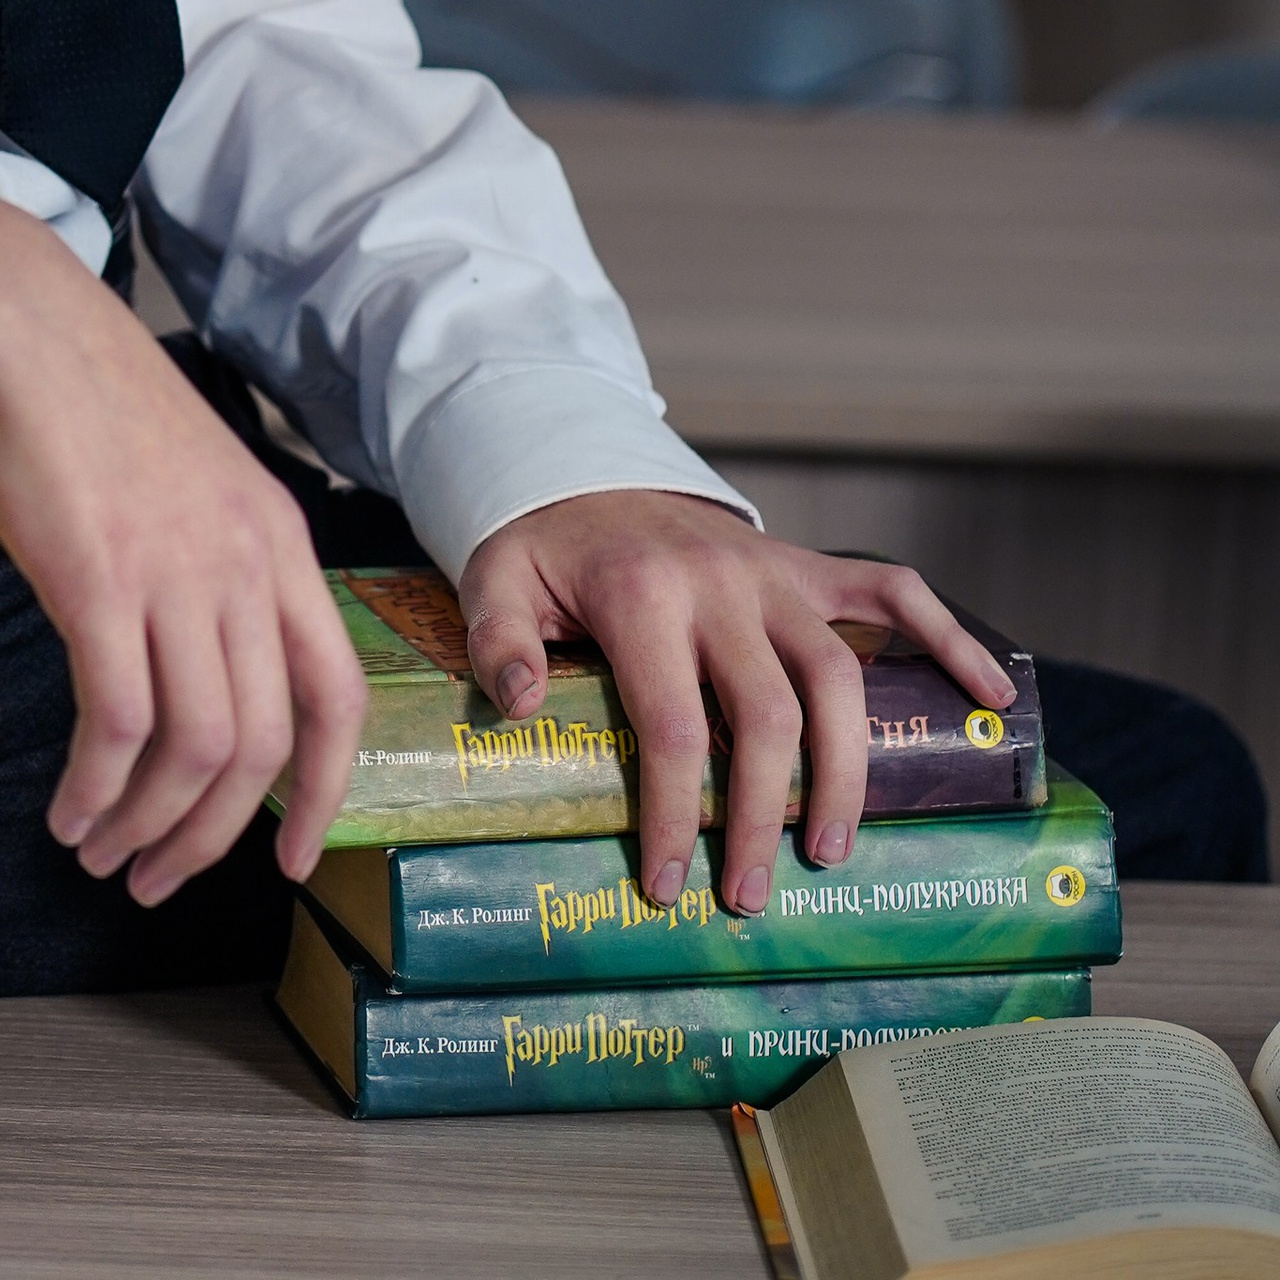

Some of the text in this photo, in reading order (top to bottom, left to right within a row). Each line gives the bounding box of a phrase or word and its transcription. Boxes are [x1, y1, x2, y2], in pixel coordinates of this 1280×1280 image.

[358, 748, 433, 768] К. Ролинг
[450, 721, 534, 794] Гарри
[534, 716, 636, 771] Поттер
[418, 906, 533, 931] Дж. К. Ролинг
[535, 881, 616, 957] Гарри
[382, 1037, 499, 1059] Дж. К. Ролинг
[502, 1012, 687, 1088] Гарри Поттер
